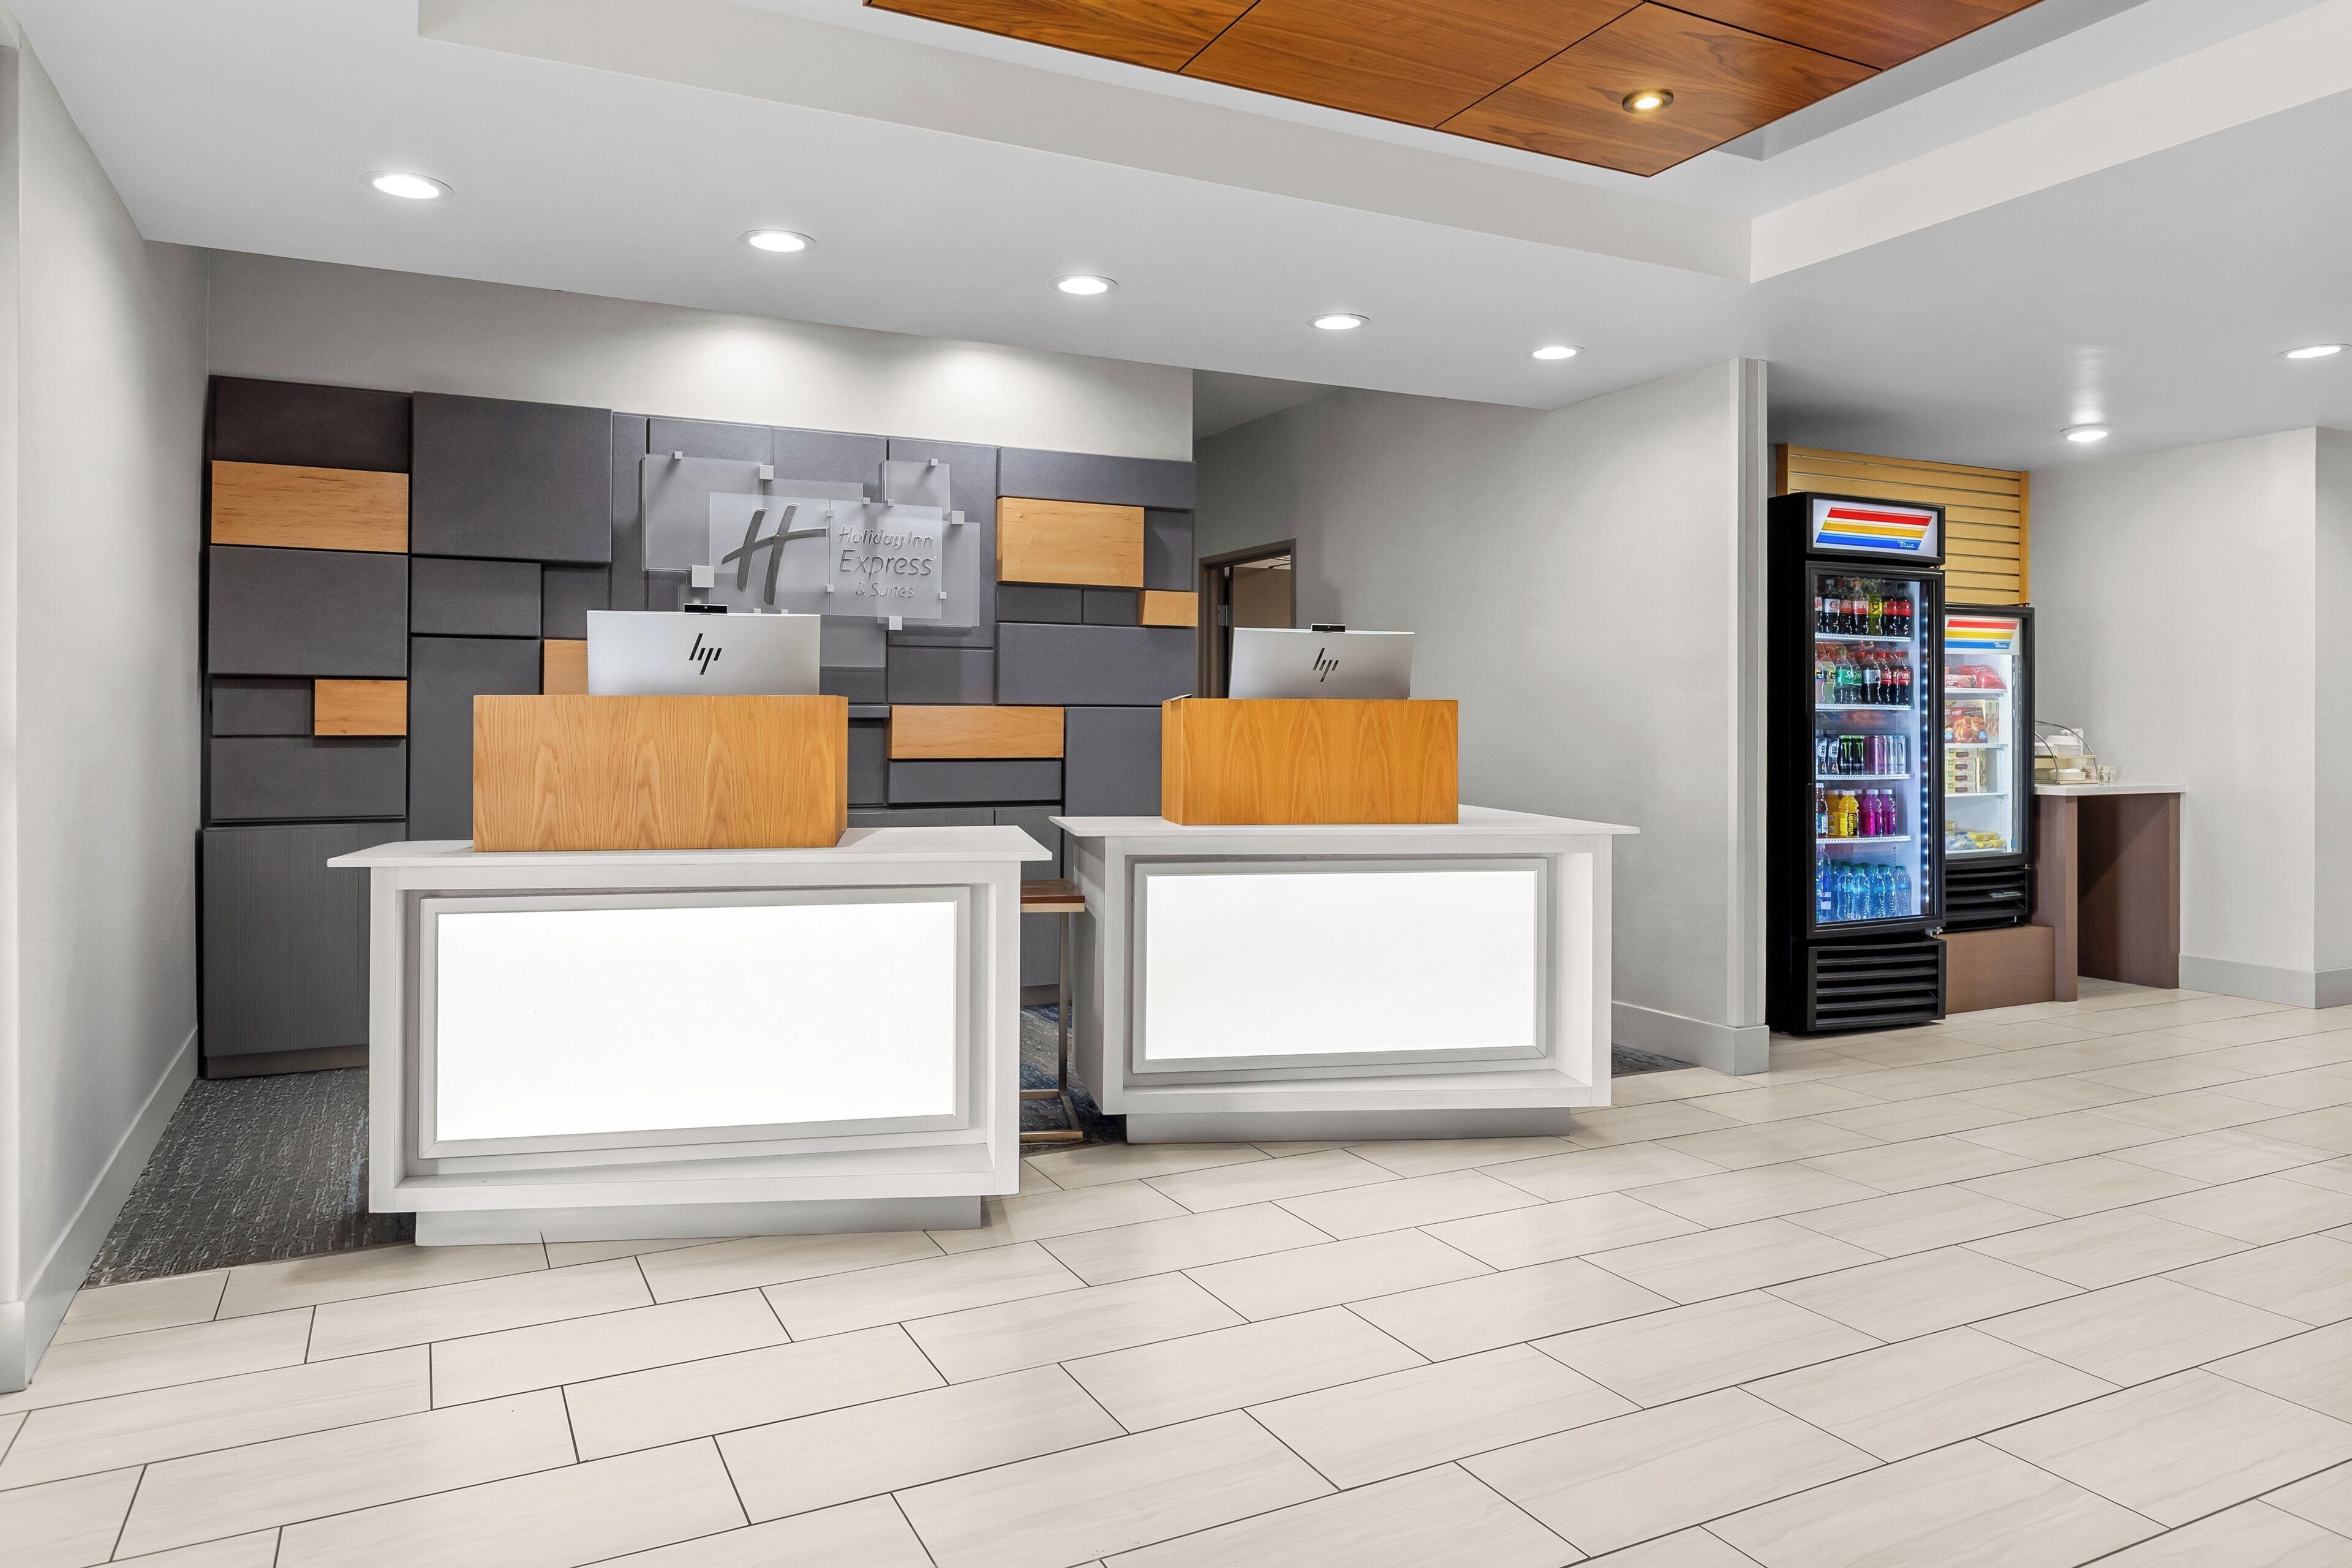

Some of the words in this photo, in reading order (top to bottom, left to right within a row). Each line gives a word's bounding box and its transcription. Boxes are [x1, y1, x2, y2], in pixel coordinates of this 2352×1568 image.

[722, 503, 829, 606] H
[839, 526, 905, 550] Holiday
[908, 529, 934, 548] Inn
[840, 549, 933, 579] Express
[855, 581, 867, 597] &
[870, 582, 916, 598] Suites
[688, 633, 723, 676] hp
[1312, 647, 1340, 683] hp
